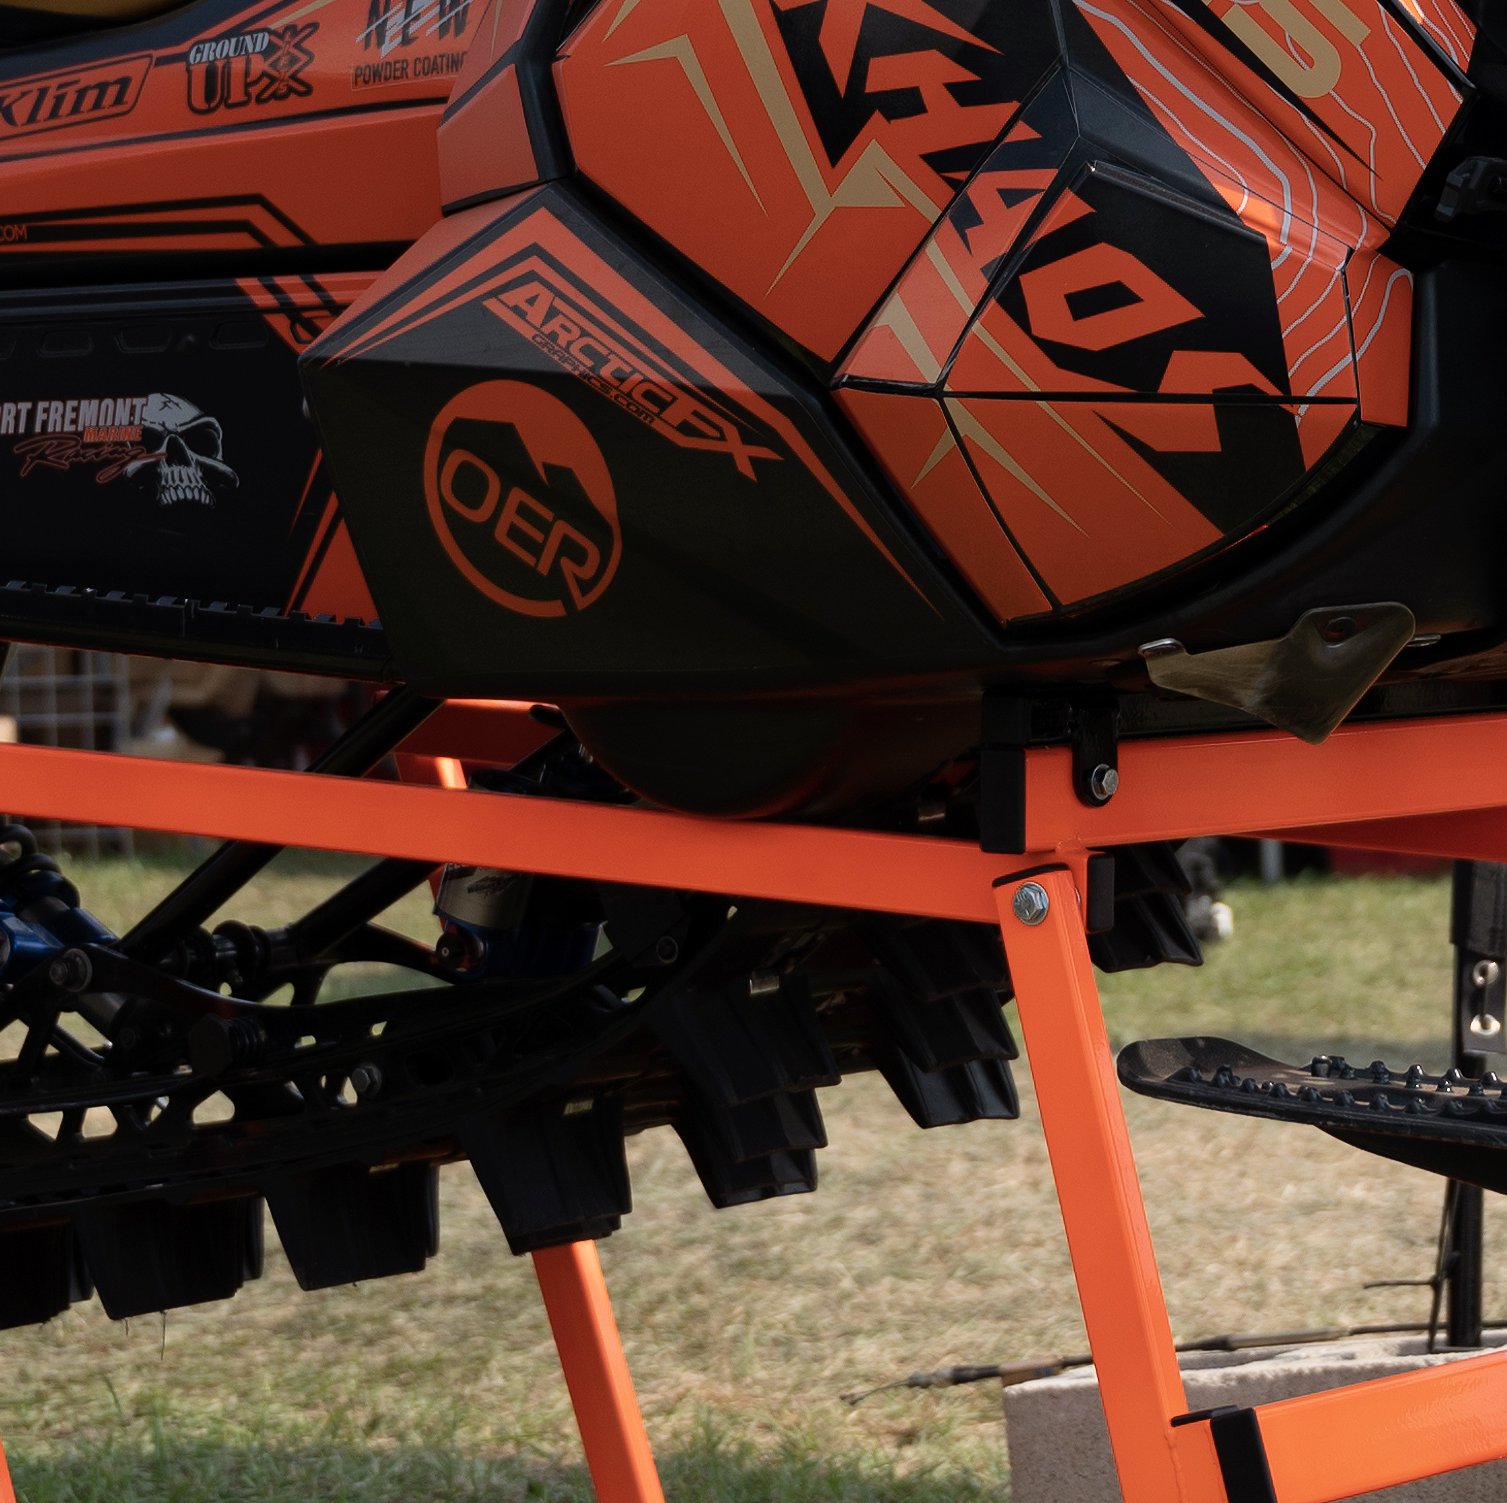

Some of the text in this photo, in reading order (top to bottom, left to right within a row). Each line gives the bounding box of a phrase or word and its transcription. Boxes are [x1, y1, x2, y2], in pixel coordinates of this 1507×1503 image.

[189, 32, 270, 65] GROUND
[354, 58, 410, 87] POWDER
[35, 397, 148, 433] FREMONT
[83, 425, 142, 443] MARINE
[13, 434, 168, 484] Racing
